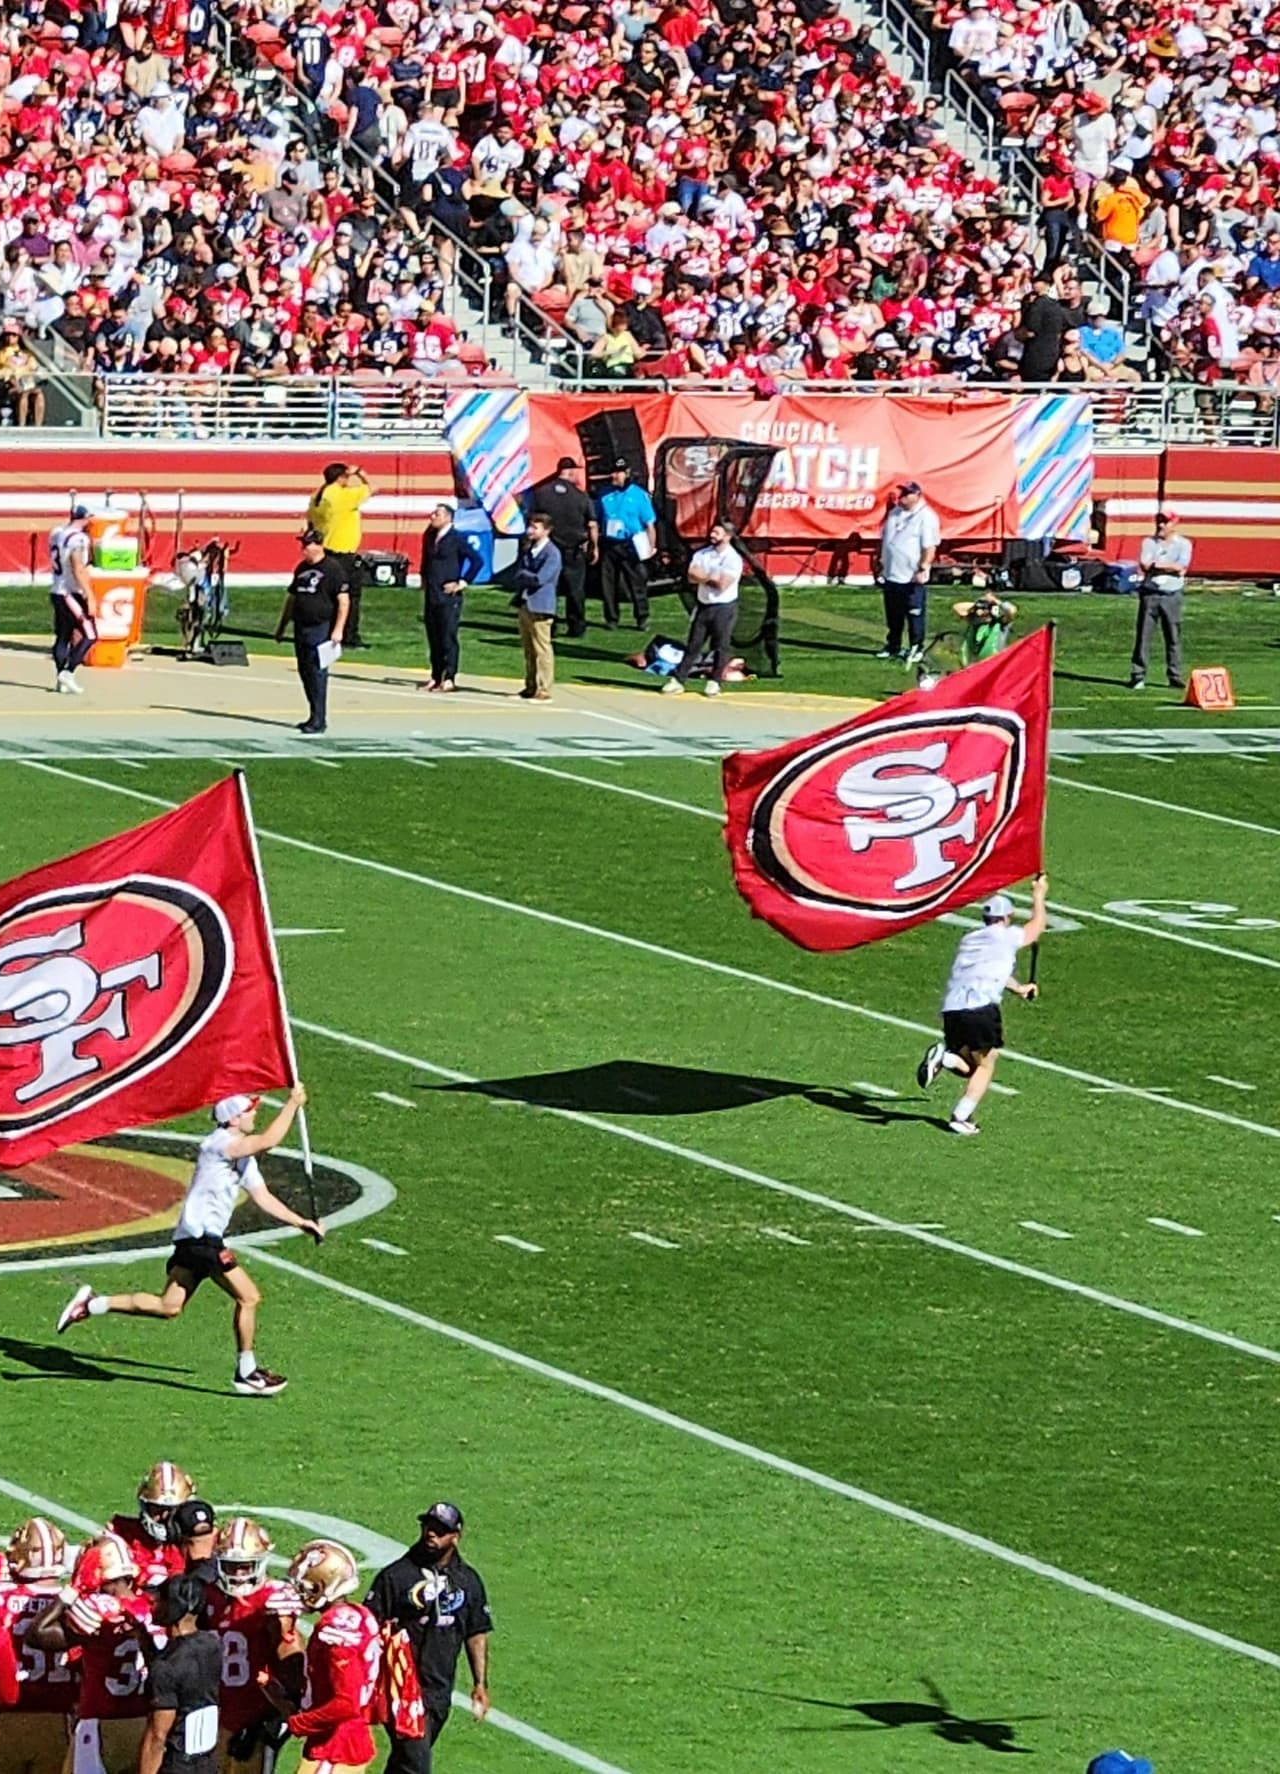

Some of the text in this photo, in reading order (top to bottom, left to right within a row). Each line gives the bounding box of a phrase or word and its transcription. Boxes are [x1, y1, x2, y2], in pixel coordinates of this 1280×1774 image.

[739, 420, 839, 444] CRUCIAL
[737, 444, 880, 493] ATCH
[1200, 673, 1228, 703] 20
[835, 741, 999, 892] SF
